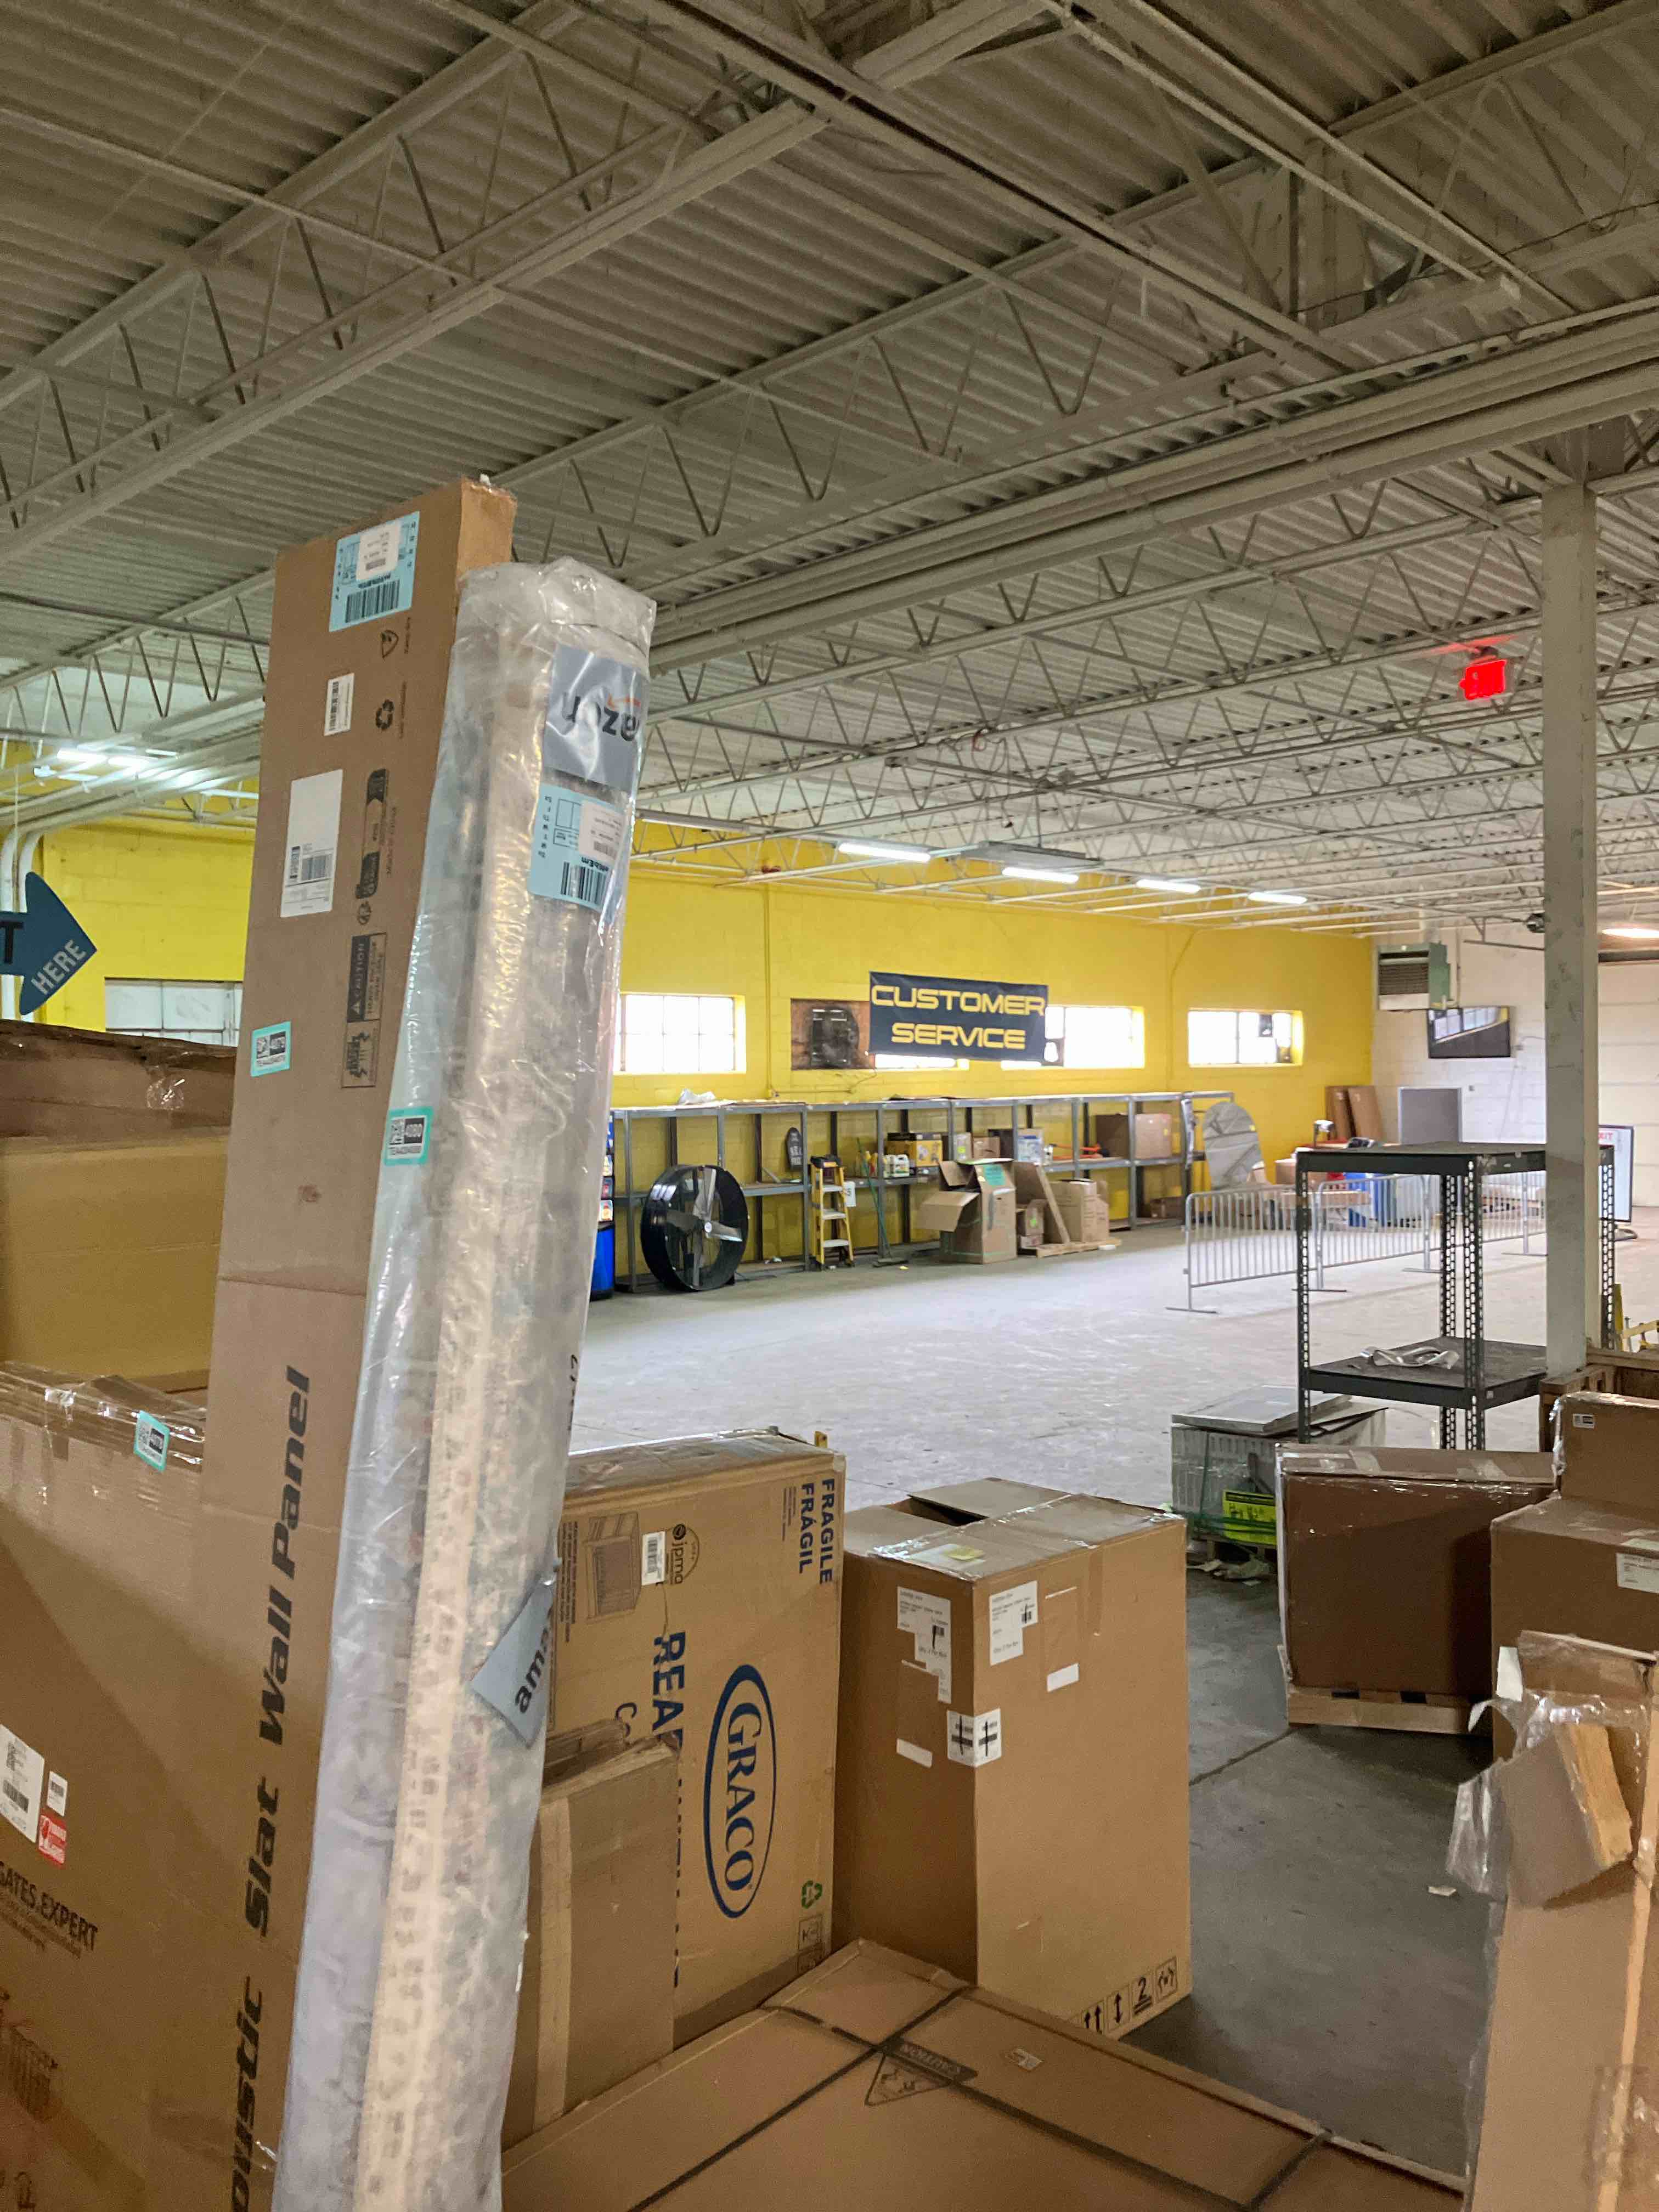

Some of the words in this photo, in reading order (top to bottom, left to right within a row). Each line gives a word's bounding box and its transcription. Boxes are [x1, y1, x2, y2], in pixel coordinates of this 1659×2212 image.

[31, 940, 87, 995] HERE
[872, 985, 1045, 1015] CUSTOMER
[891, 1023, 1026, 1049] SERVICE
[272, 1365, 311, 1580] Panel
[672, 1541, 687, 1584] jpma
[799, 1482, 817, 1574] FRÁGIL
[820, 1478, 834, 1585] FRAGILE
[259, 1585, 293, 1745] Wall
[725, 1702, 763, 1892] GRACO
[245, 1776, 279, 1938] Slat
